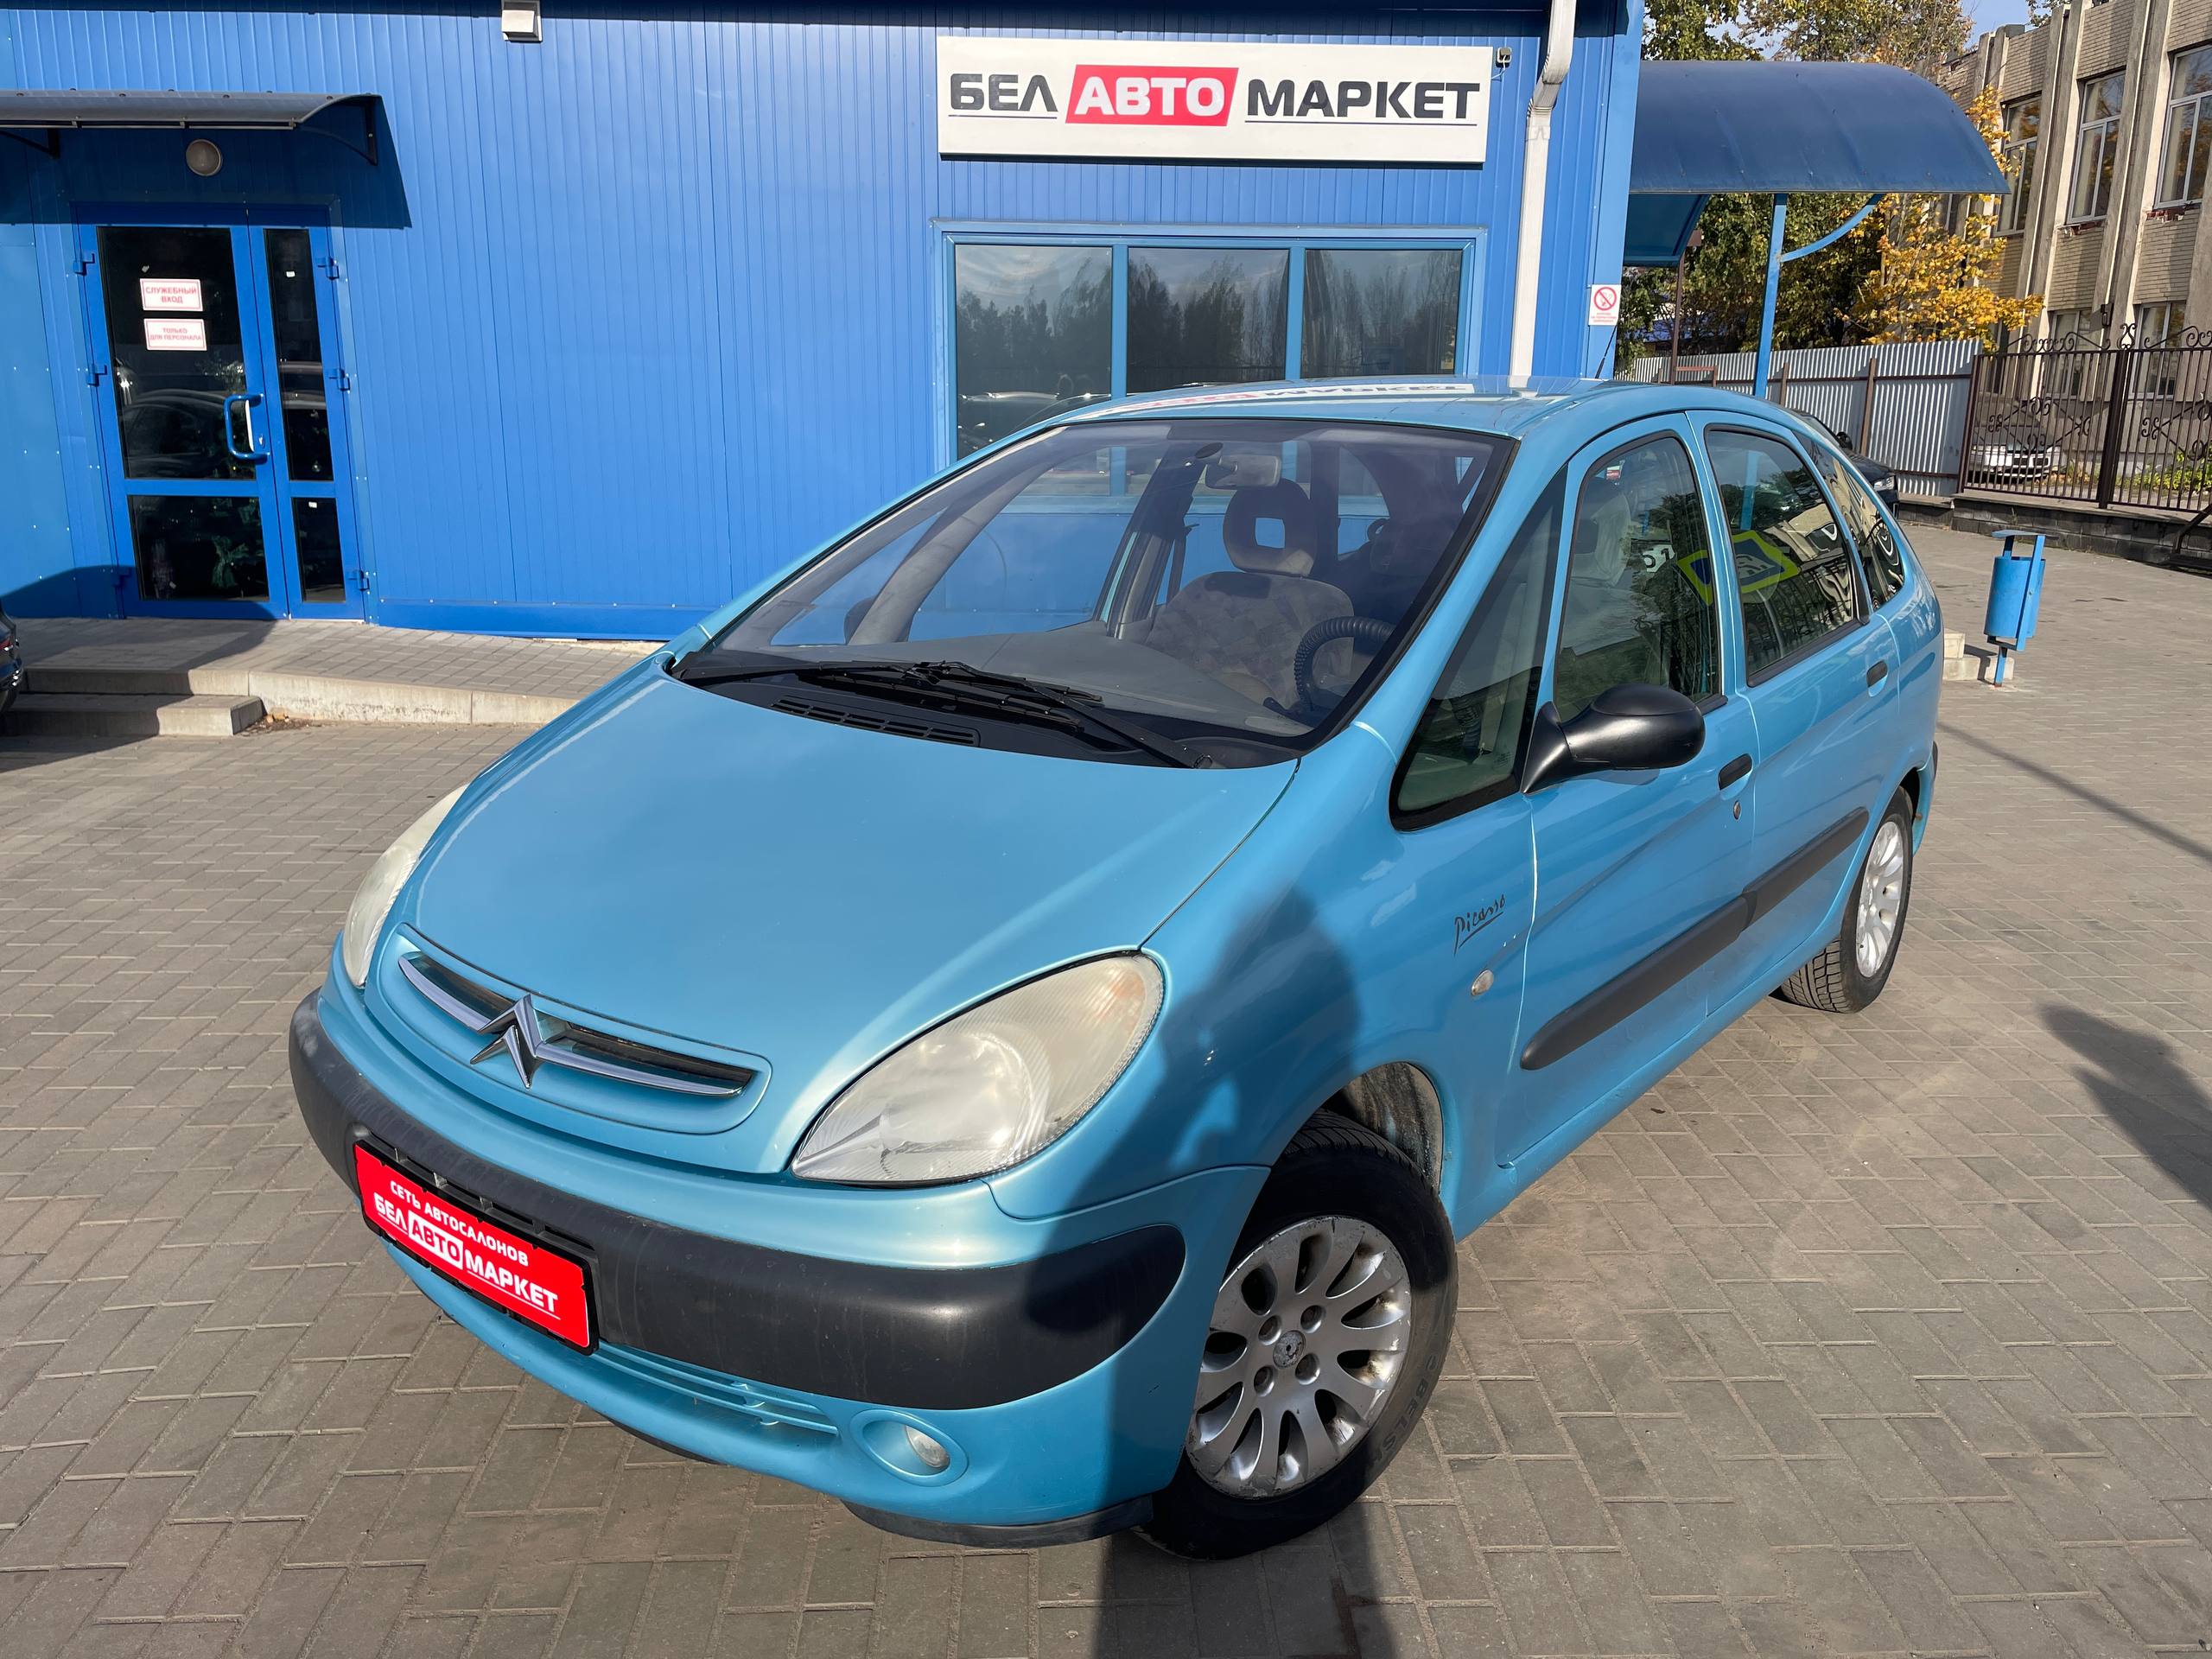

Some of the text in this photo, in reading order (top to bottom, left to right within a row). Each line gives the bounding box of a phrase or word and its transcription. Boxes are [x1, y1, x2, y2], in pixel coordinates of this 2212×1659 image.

[950, 73, 1481, 119] БЕЛ АВТО МАРКЕТ
[373, 1192, 558, 1313] БЕЛ АВТО МАРКЕТ
[390, 1180, 529, 1267] СЕТЬ АВТОСАЛОНОВ
